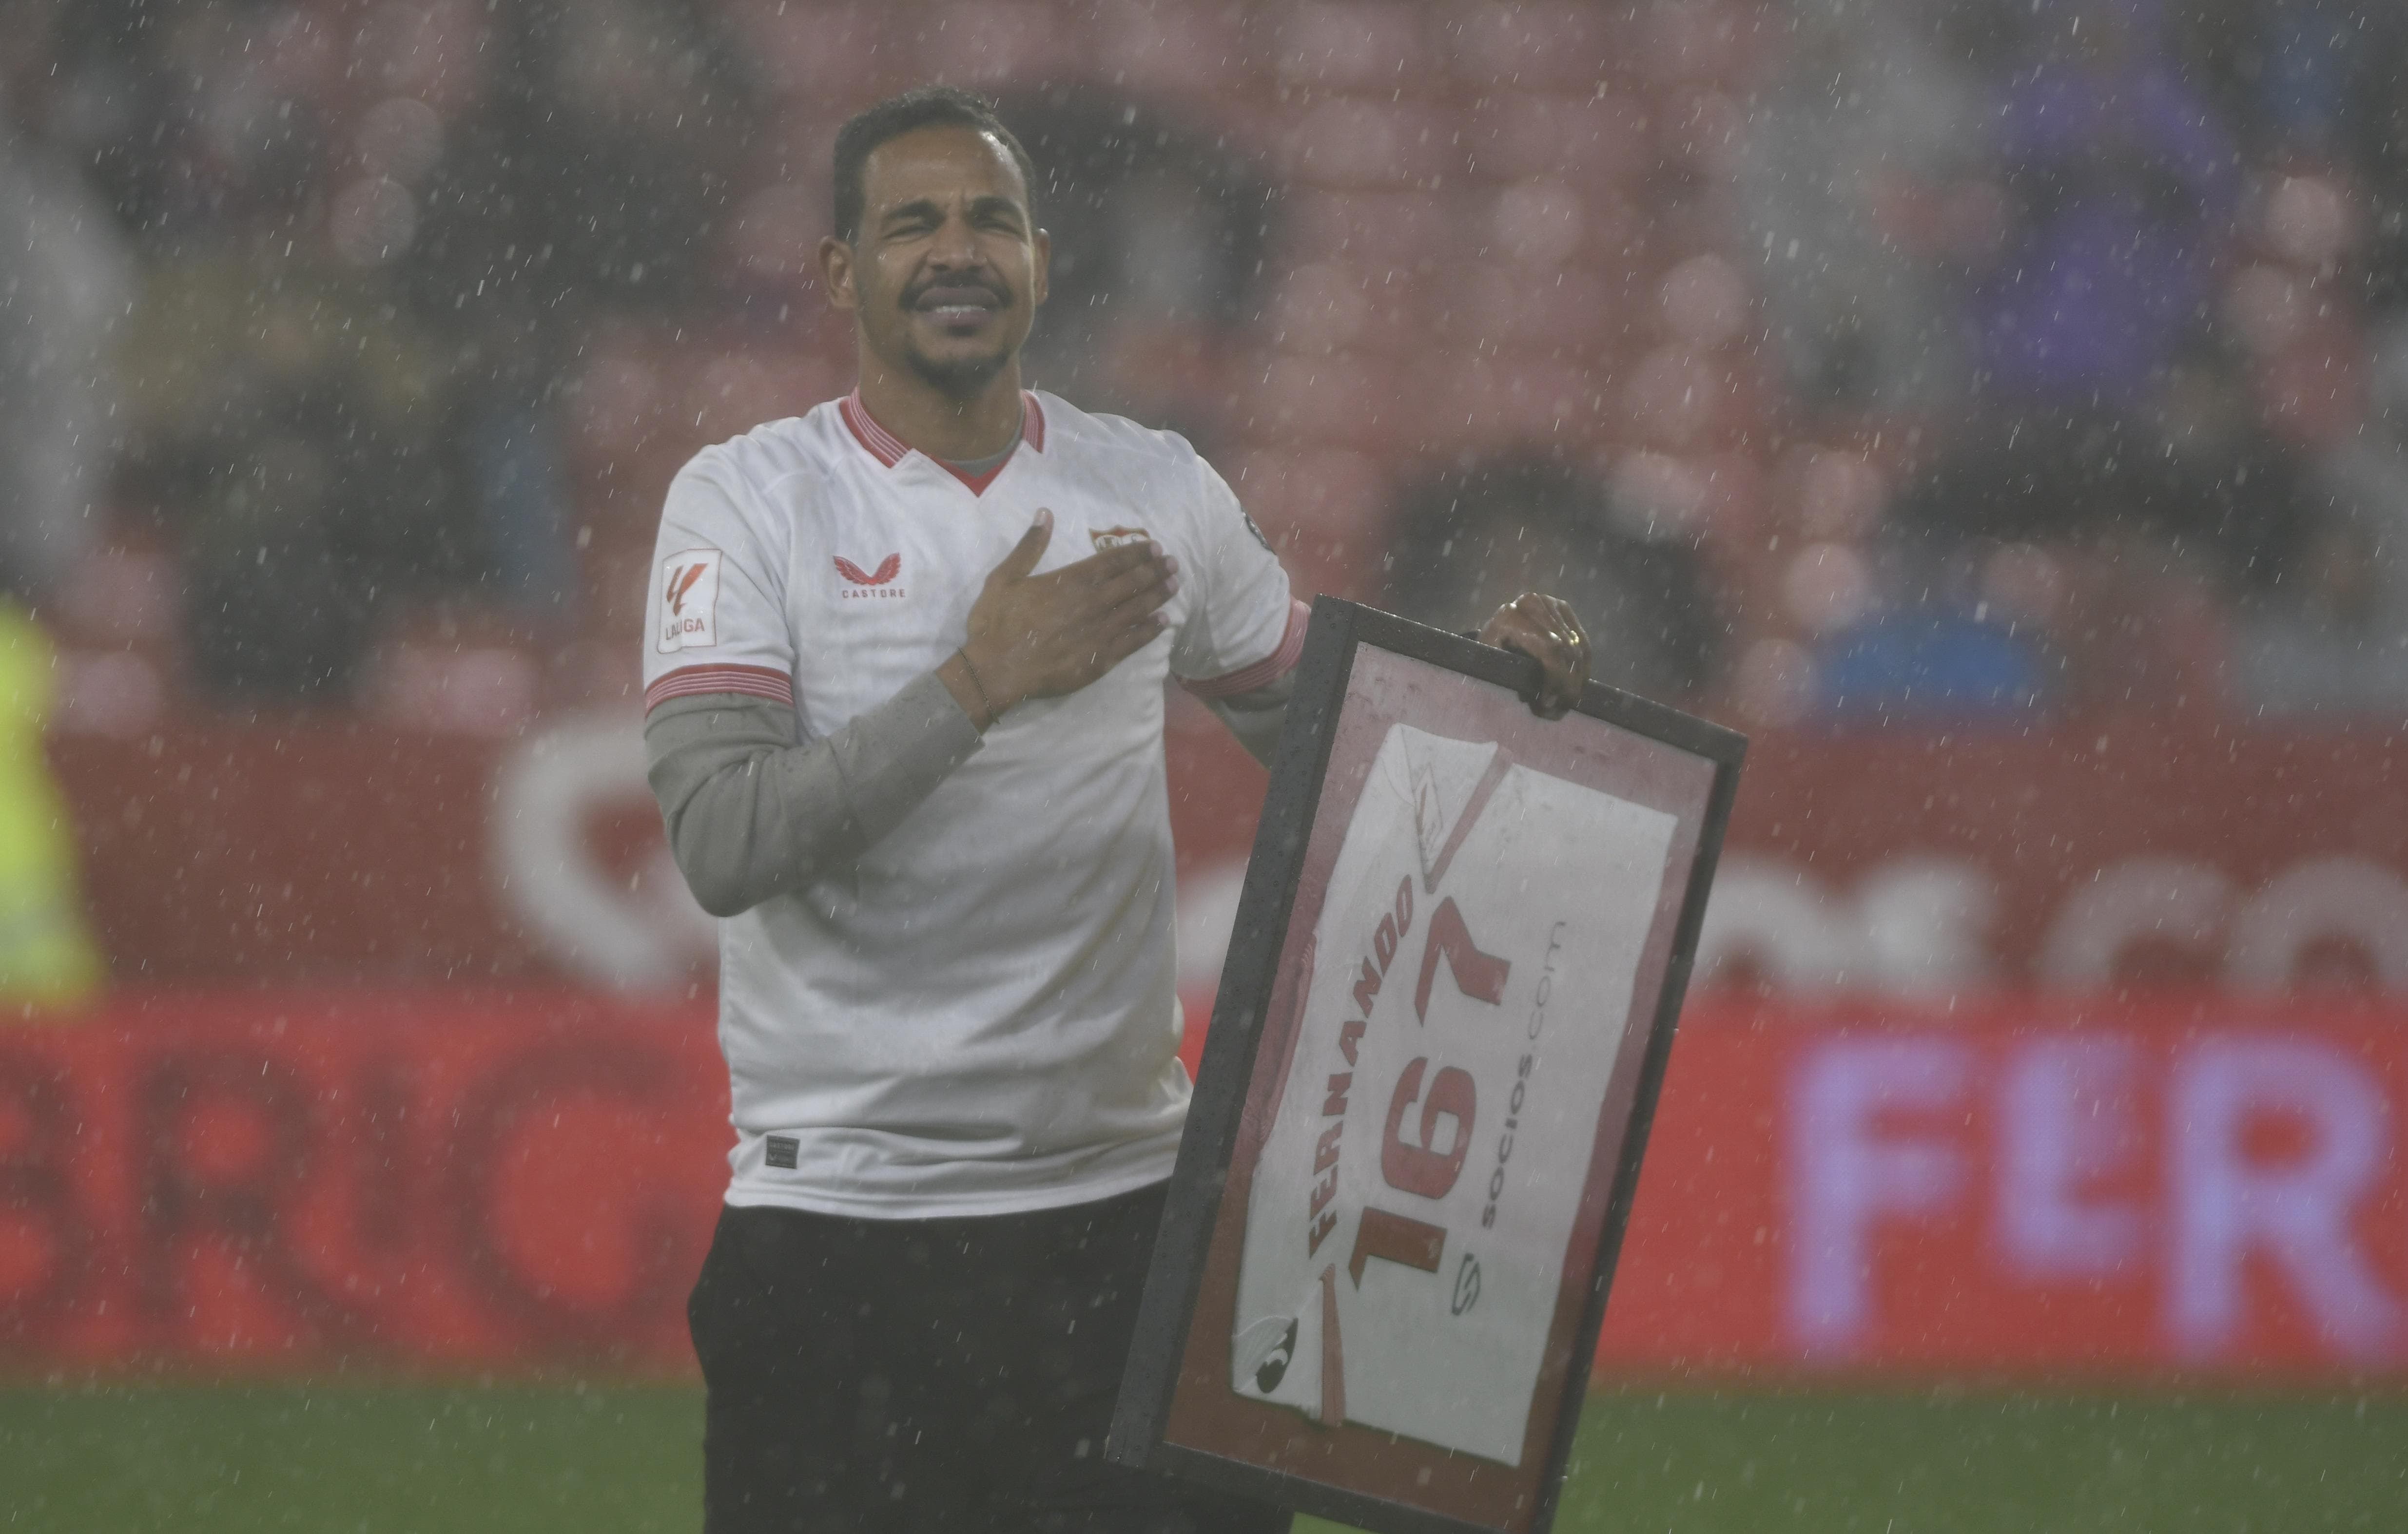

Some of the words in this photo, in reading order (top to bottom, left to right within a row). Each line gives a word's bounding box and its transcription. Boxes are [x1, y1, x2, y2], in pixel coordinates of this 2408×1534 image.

[665, 617, 705, 640] LALIGA
[842, 589, 906, 599] CASTORE
[1308, 874, 1414, 1260] FERNANDO
[1348, 895, 1512, 1292] 167
